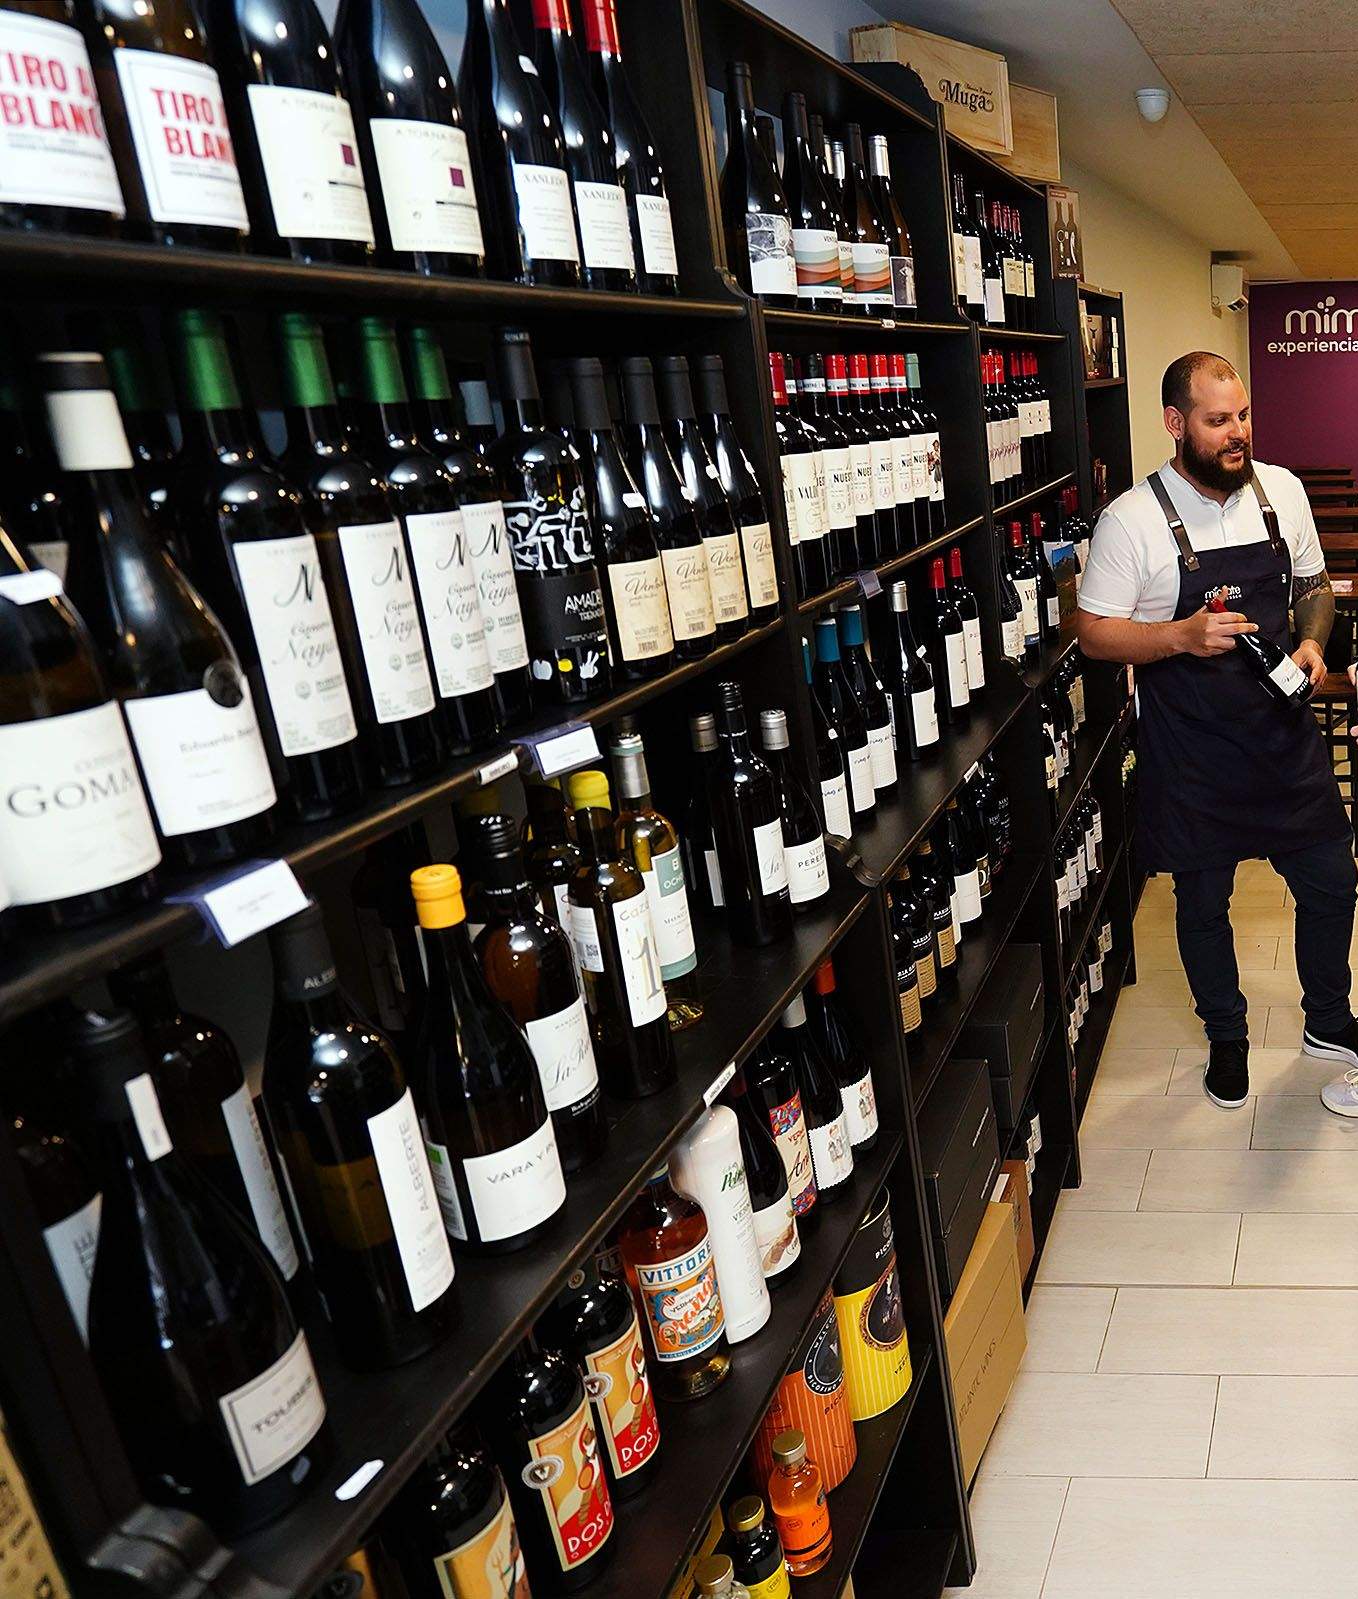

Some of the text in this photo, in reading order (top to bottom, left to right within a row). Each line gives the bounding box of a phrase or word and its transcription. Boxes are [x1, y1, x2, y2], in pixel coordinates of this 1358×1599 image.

[151, 87, 215, 125] TIRO
[939, 78, 995, 113] Muga
[487, 1160, 534, 1185] VARA
